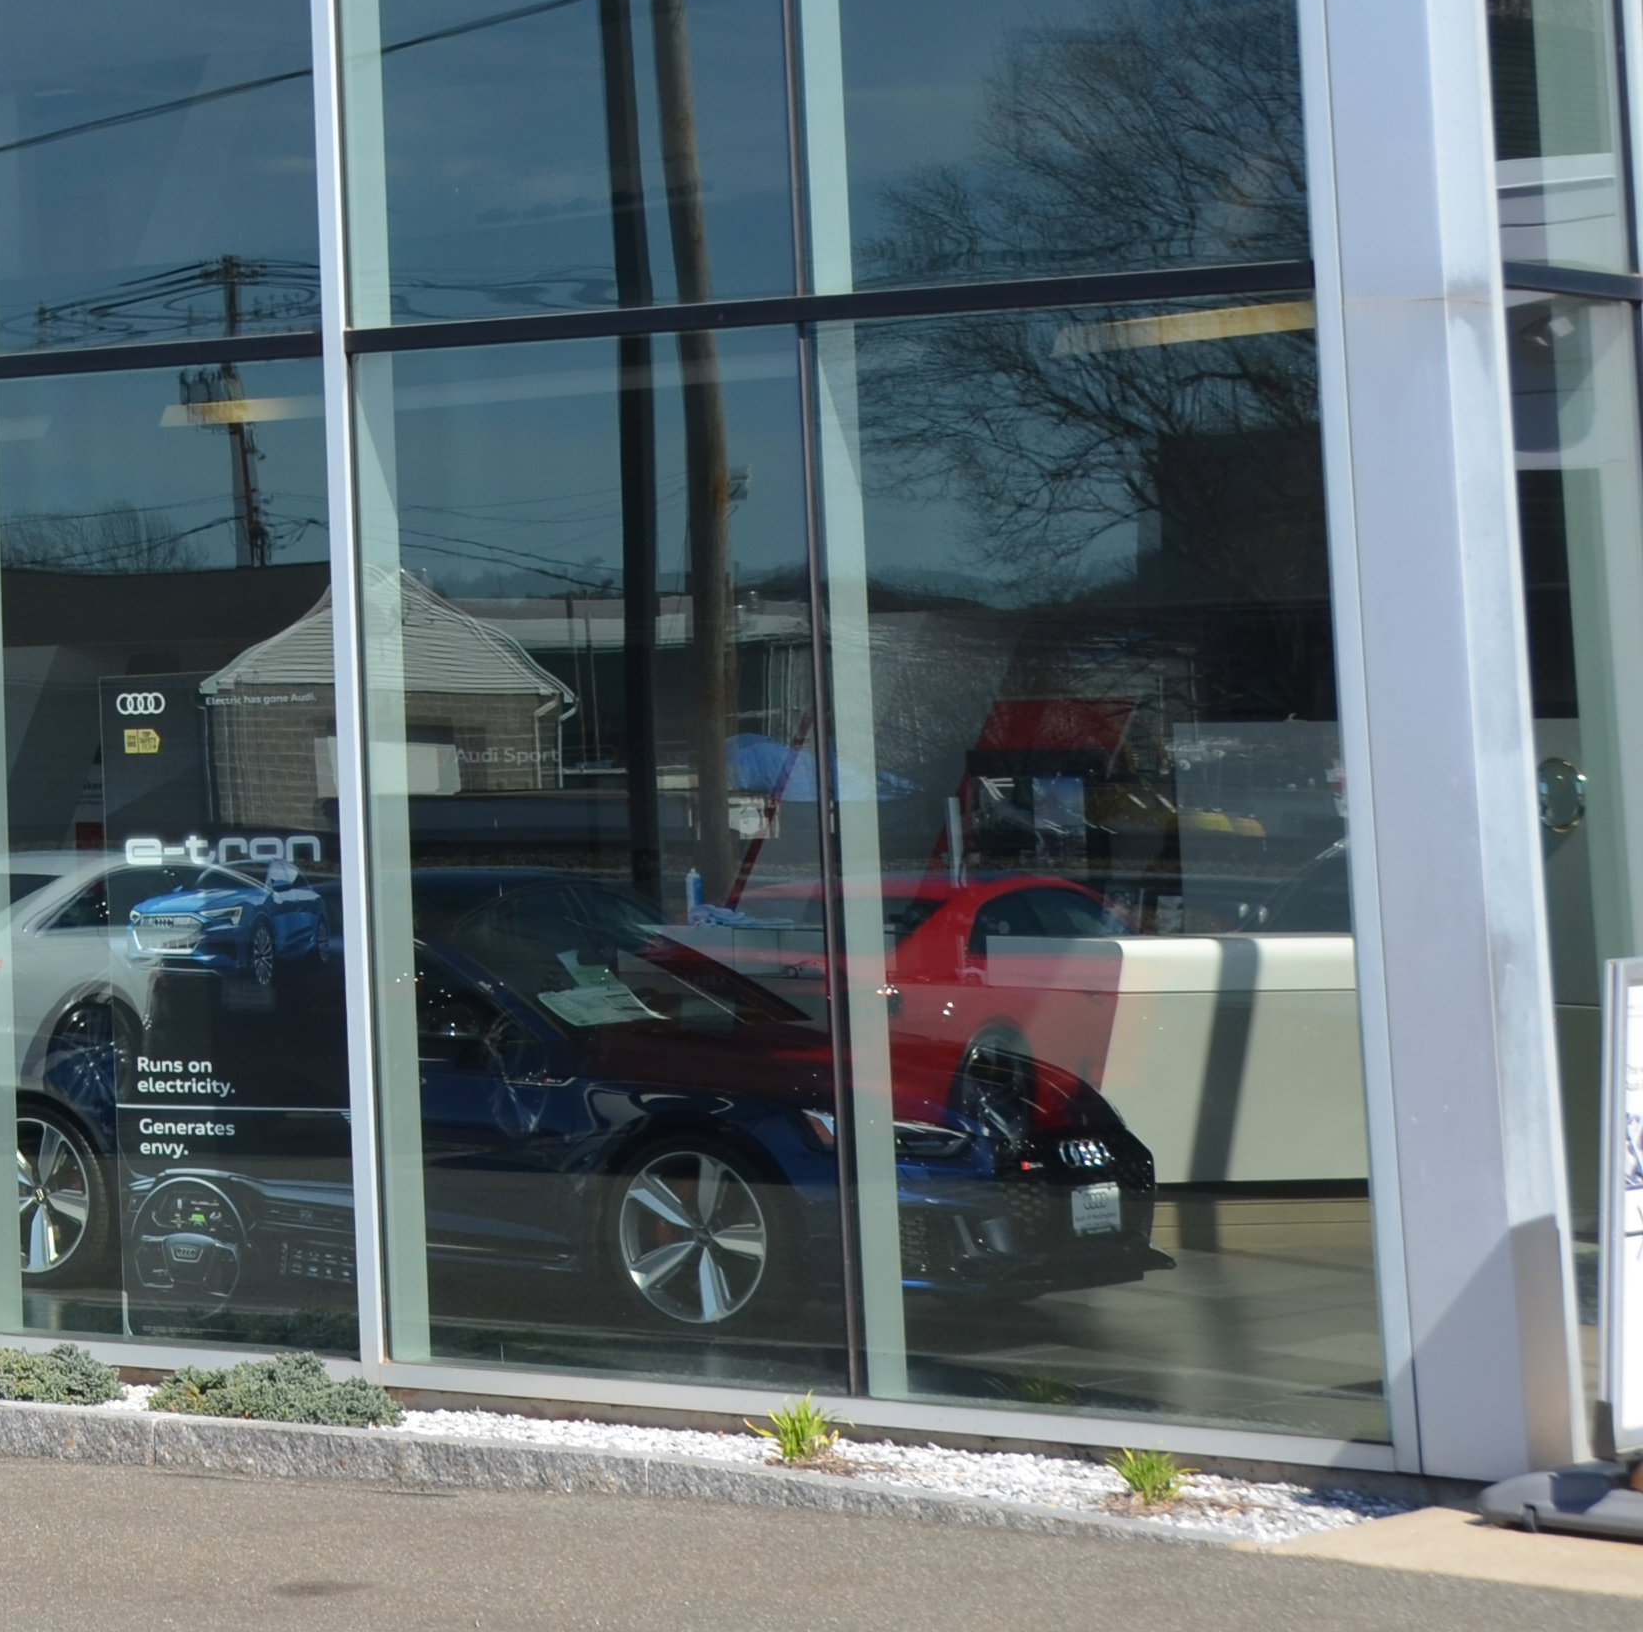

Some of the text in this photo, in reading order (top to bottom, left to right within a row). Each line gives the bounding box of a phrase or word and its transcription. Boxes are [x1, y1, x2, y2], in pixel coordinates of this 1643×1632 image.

[205, 692, 317, 706] Electric has gone Audi.
[455, 748, 560, 766] Audi Sport
[125, 835, 321, 866] e-tron
[137, 1056, 213, 1073] Runs on
[137, 1076, 236, 1098] electricity.
[139, 1118, 235, 1136] Generates
[140, 1142, 189, 1159] envy.
